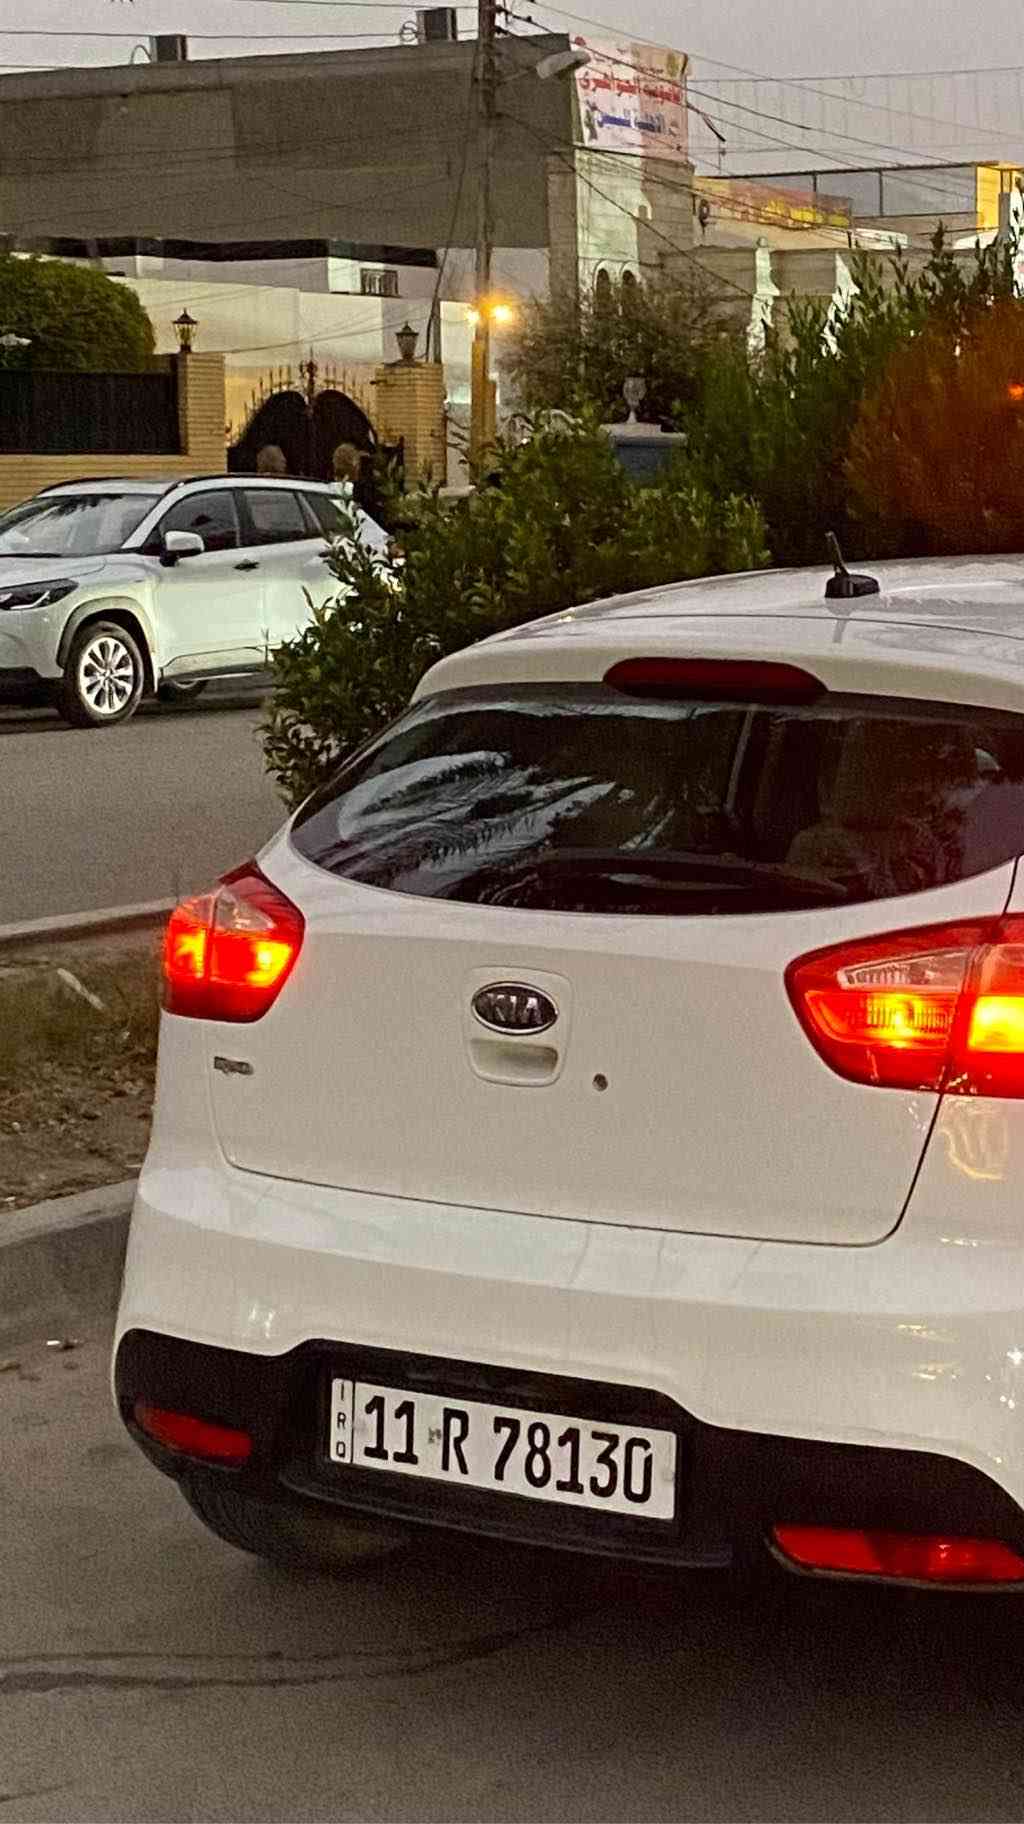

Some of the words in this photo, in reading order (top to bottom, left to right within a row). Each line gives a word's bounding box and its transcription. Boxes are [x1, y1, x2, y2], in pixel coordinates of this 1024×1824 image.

[364, 1395, 418, 1465] 11
[442, 1407, 469, 1475] R
[494, 1416, 653, 1503] 78130
